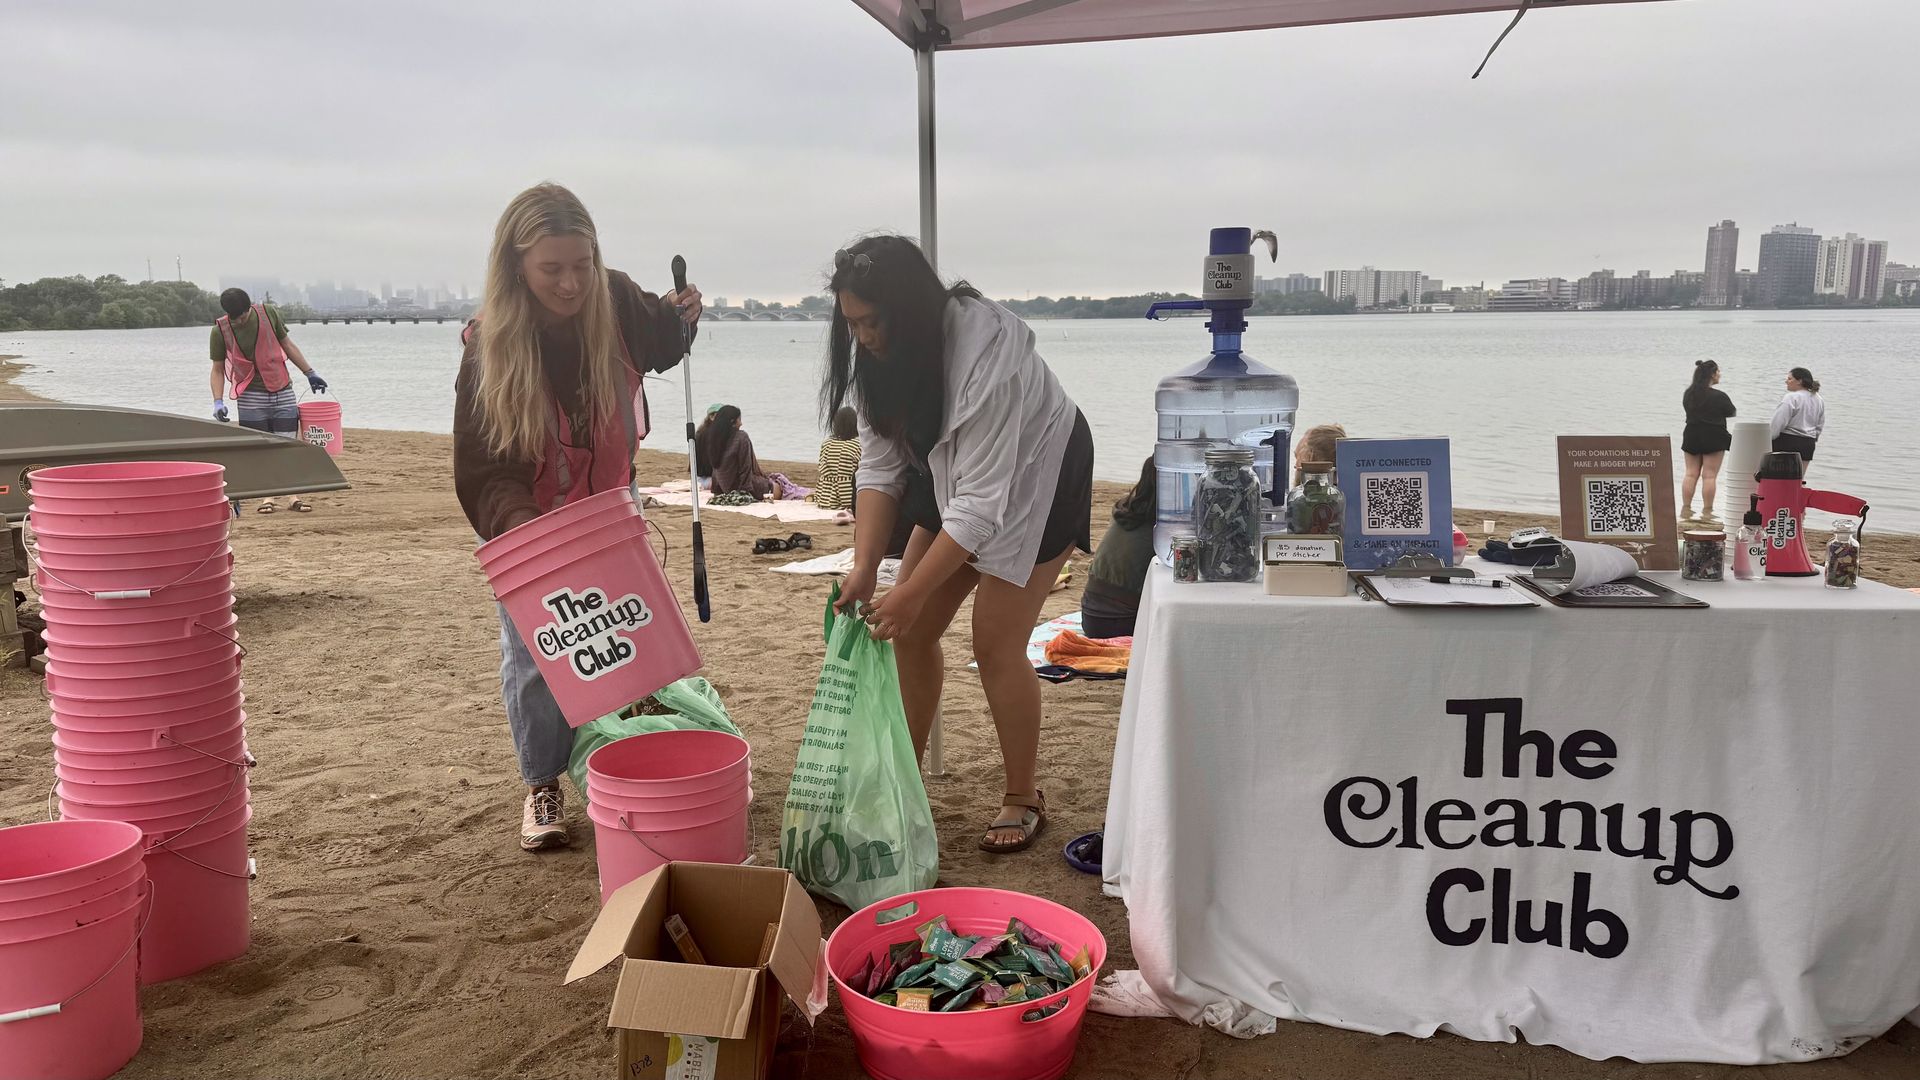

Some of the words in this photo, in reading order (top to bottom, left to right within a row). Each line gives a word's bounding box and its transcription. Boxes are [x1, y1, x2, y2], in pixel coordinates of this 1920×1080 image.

[1216, 262, 1232, 271] The
[1208, 271, 1242, 280] Cleanup
[1215, 280, 1233, 289] Club
[1588, 449, 1630, 457] DONATIONS
[1631, 449, 1650, 457] HELP
[1651, 449, 1661, 457] US
[1355, 459, 1376, 468] STAY
[1378, 458, 1432, 467] CONNECTED
[1573, 460, 1592, 468] MAKE
[1593, 460, 1599, 468] A
[1600, 460, 1627, 468] BIGGER
[1766, 519, 1777, 535] The
[1774, 508, 1789, 547] Cleanup
[1786, 519, 1796, 538] Club
[1353, 540, 1361, 549] &
[1276, 551, 1288, 559] per
[547, 592, 603, 624] The
[537, 598, 649, 656] Cleanup
[574, 635, 632, 676] Club
[1446, 697, 1617, 780] The
[1324, 776, 1739, 900] Cleanup
[1426, 867, 1629, 959] Club
